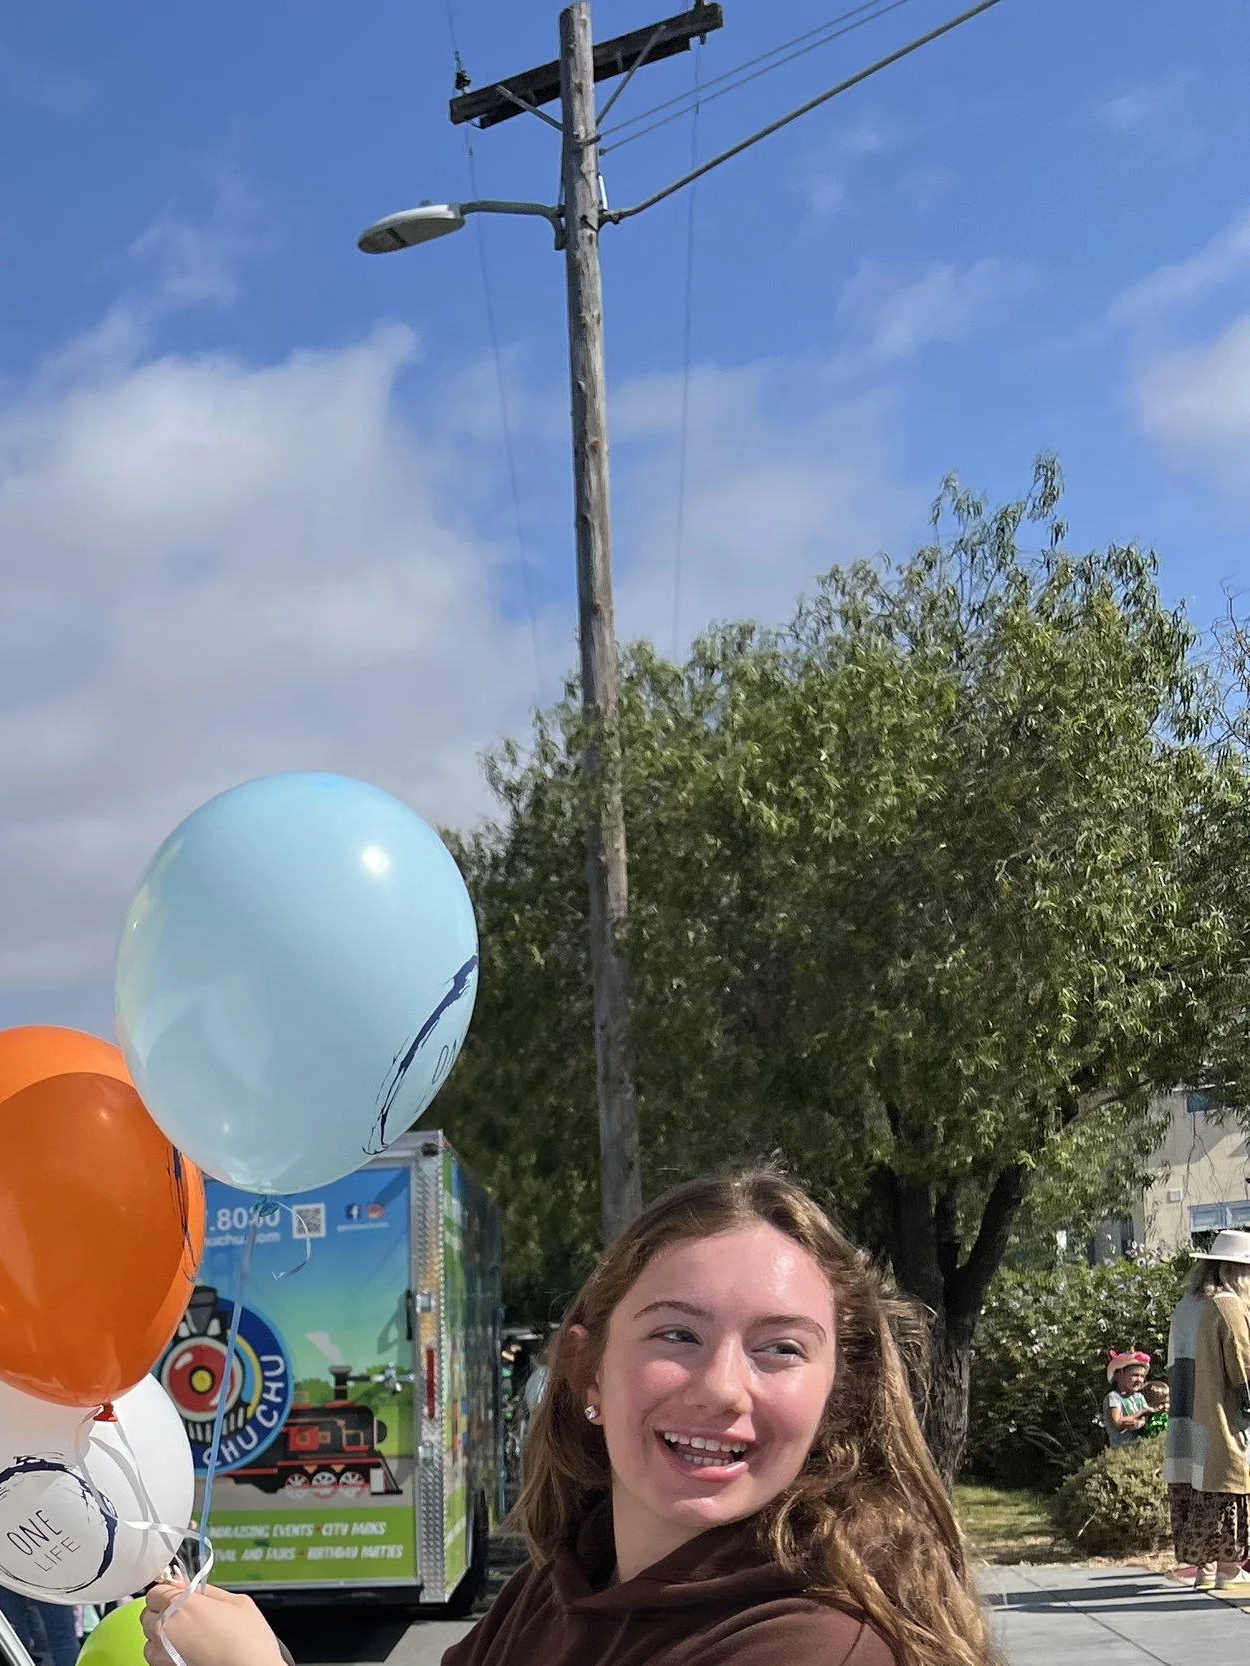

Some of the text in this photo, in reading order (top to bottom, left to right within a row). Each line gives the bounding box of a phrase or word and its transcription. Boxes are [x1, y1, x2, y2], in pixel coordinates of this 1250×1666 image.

[6, 1509, 63, 1556] ONE
[272, 1523, 314, 1537] EVENTS
[322, 1522, 349, 1536] CITY
[34, 1536, 81, 1572] LIFE
